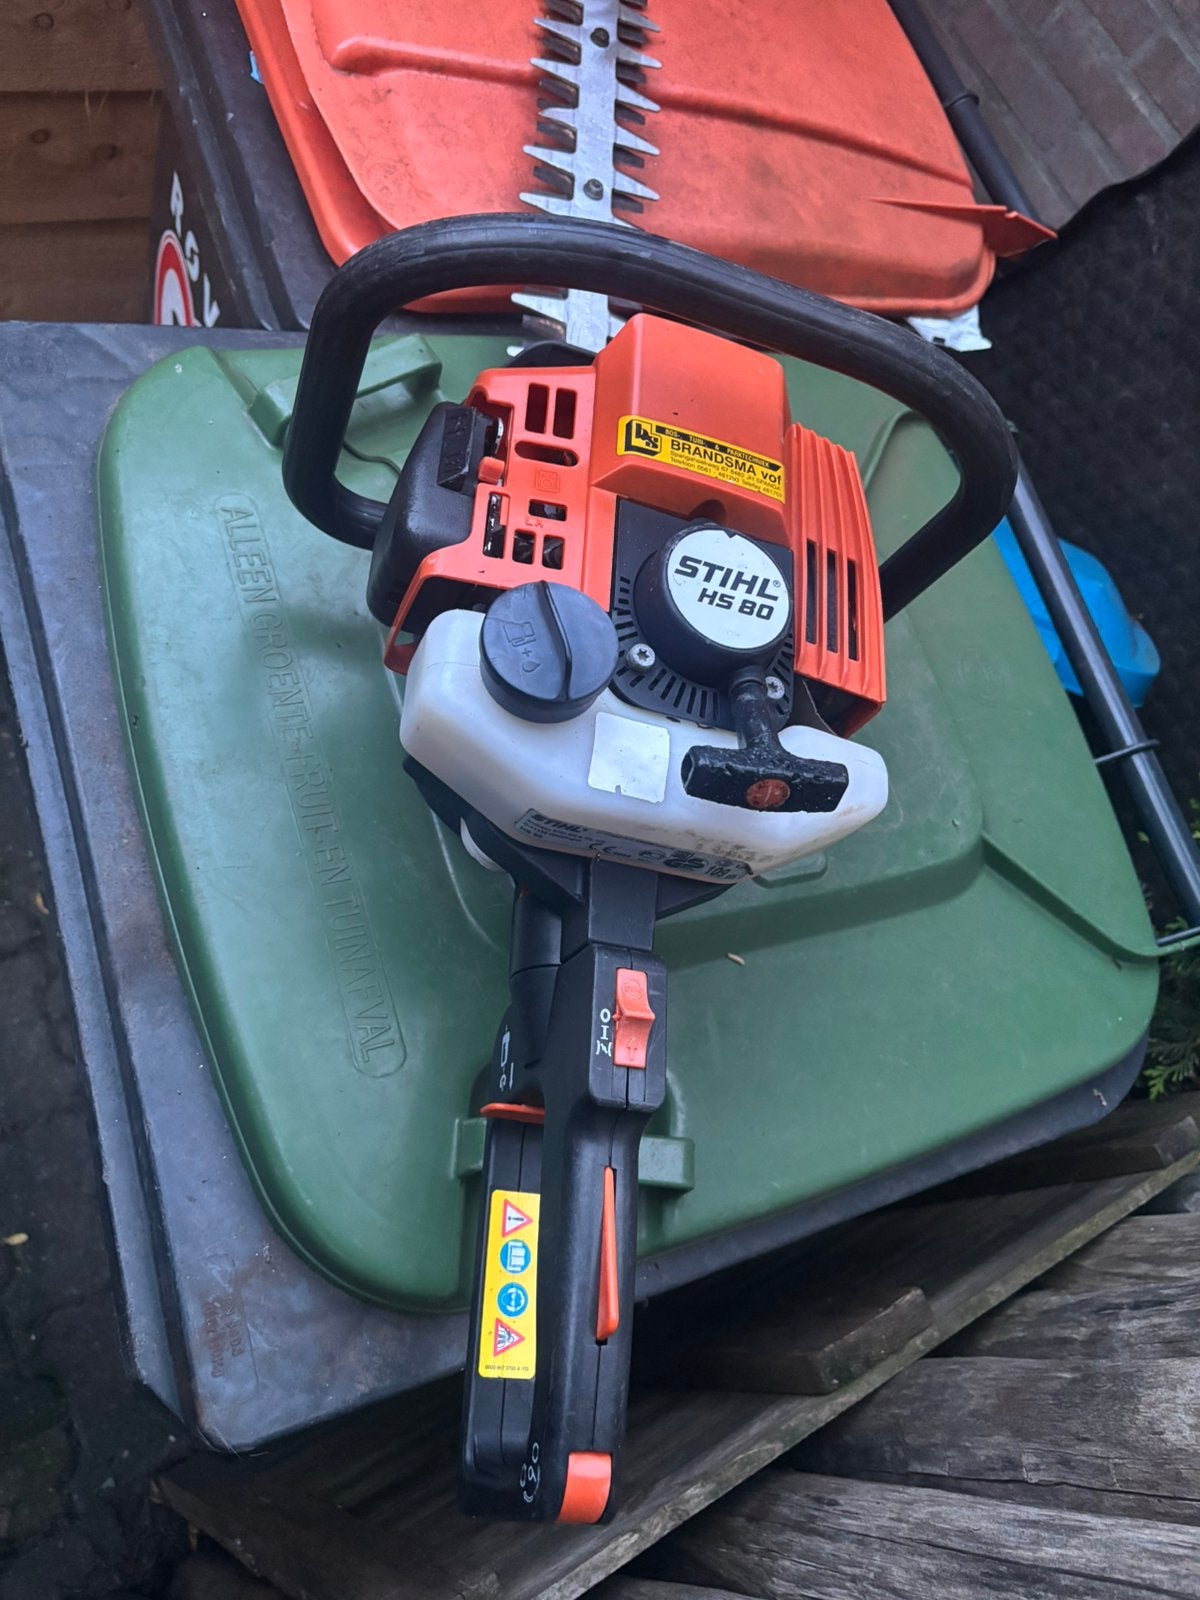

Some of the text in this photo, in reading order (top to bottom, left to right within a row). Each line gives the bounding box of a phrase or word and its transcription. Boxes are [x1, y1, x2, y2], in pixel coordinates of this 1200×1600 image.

[670, 456, 696, 469] Telefoon
[671, 439, 781, 485] BRANDSMA vof
[697, 588, 775, 621] HS 80
[220, 505, 279, 604] ALLEEN
[325, 898, 396, 1064] TUINAFVAL
